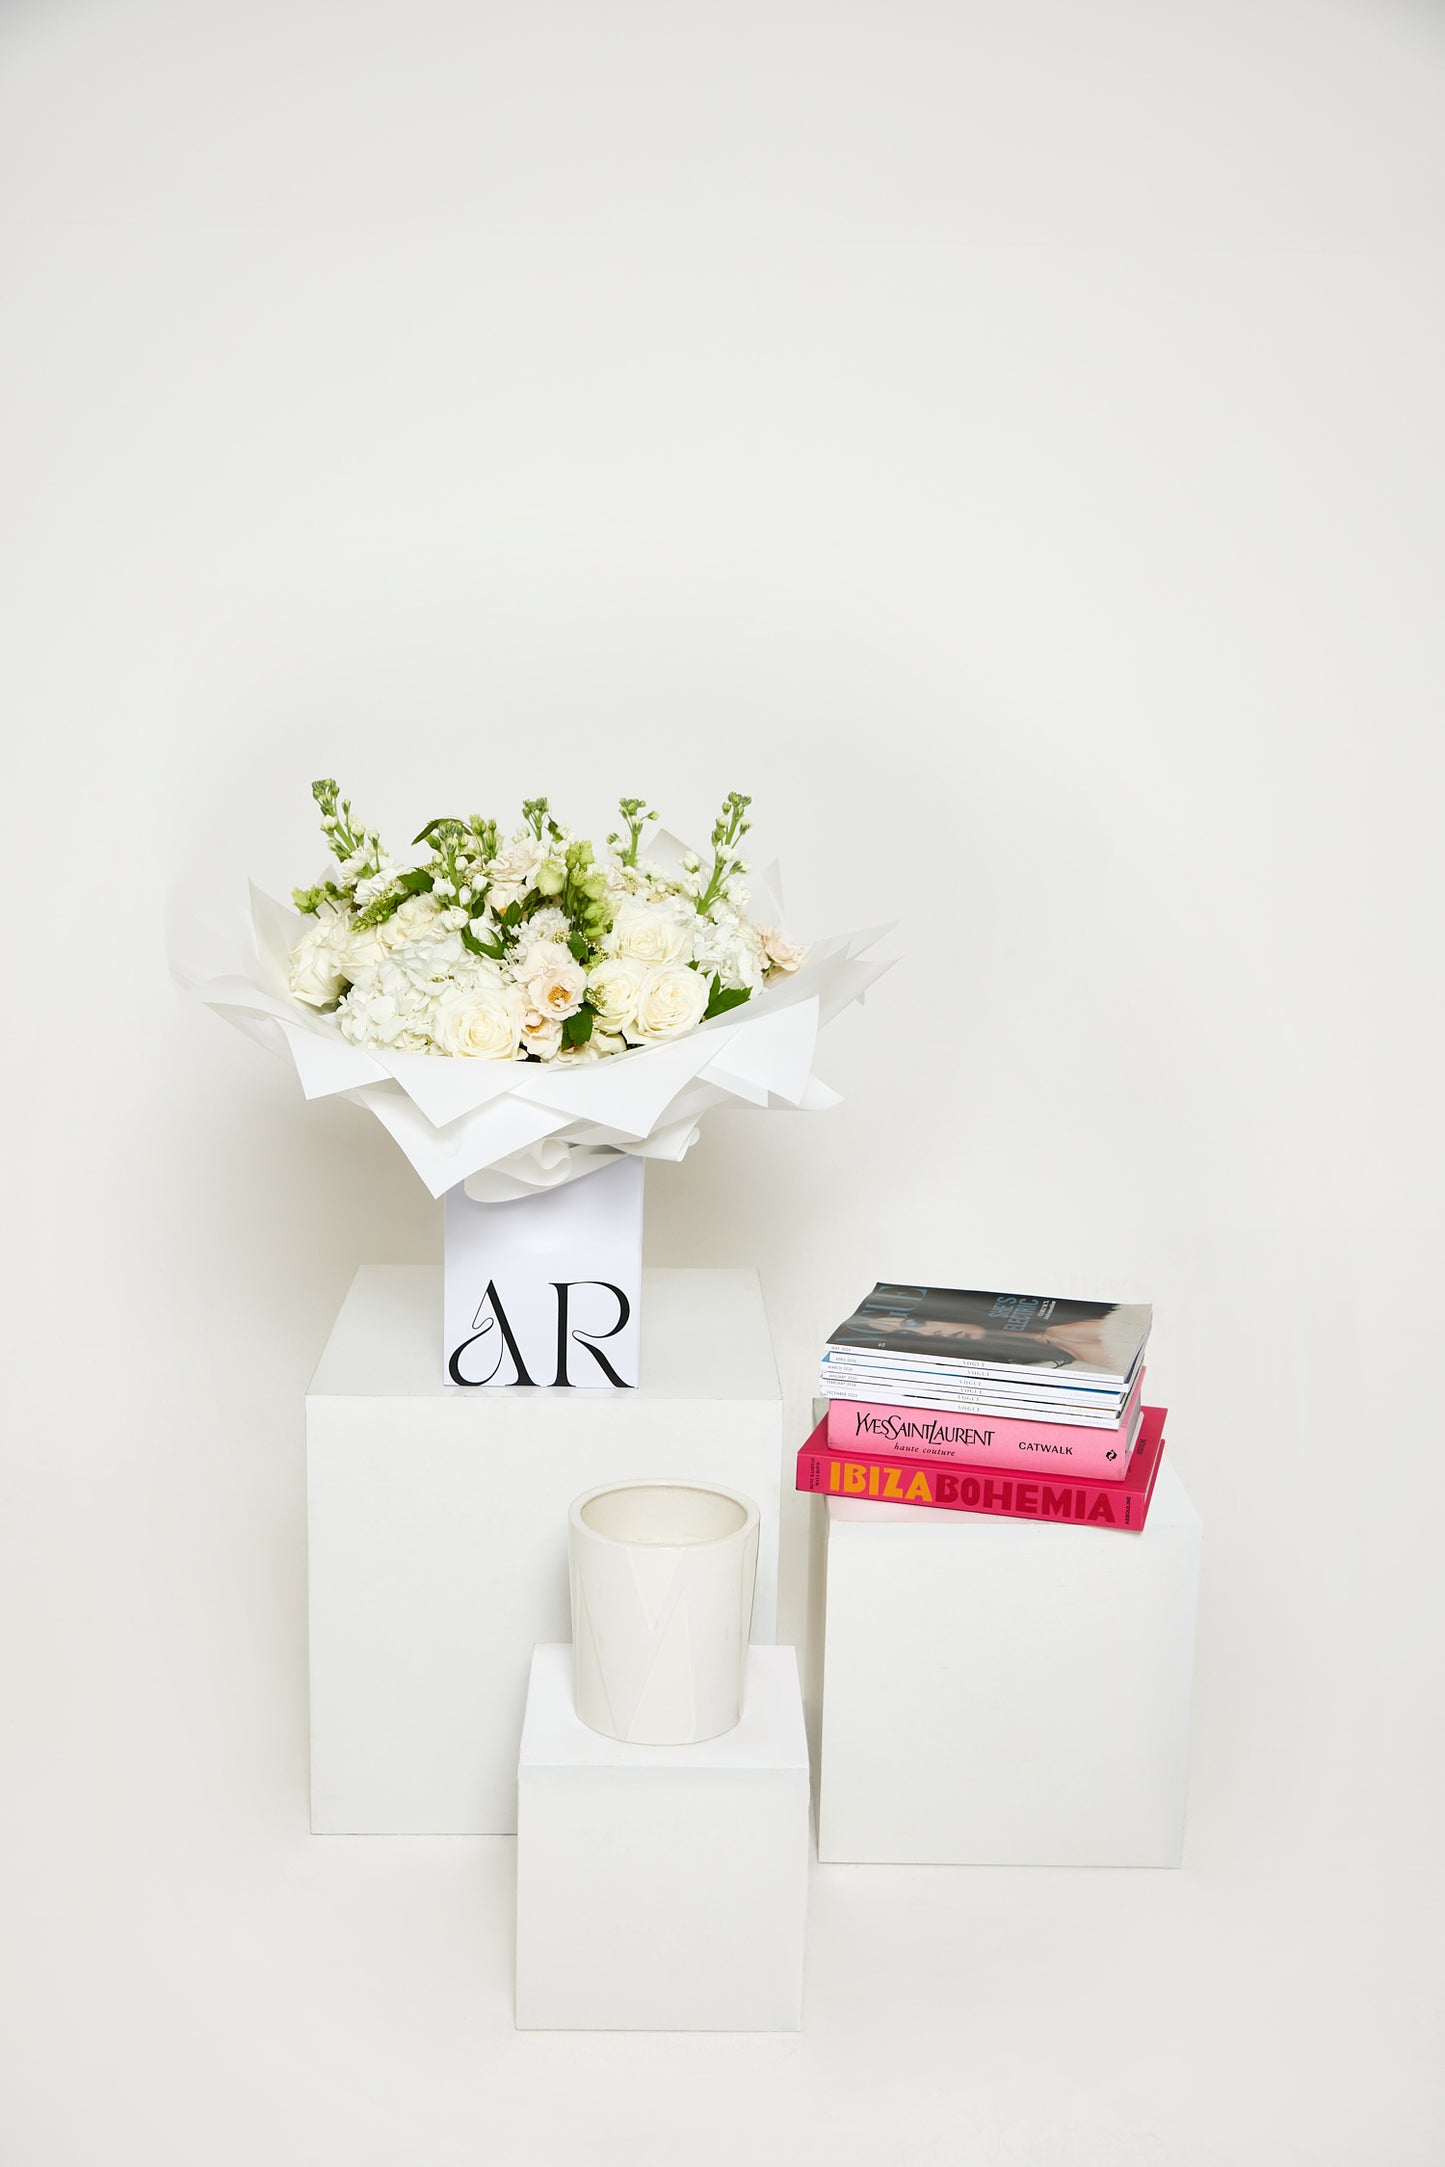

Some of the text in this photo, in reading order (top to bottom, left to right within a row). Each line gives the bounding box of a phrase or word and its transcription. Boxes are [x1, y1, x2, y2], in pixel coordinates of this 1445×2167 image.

[988, 1296, 1017, 1318] SHE'S
[1003, 1298, 1039, 1331] ELECTRIC
[448, 1279, 636, 1388] AR
[893, 1442, 956, 1457] haute couture
[1018, 1441, 1074, 1456] CATWALK
[829, 1461, 1116, 1524] IBIZA BOHEMIA
